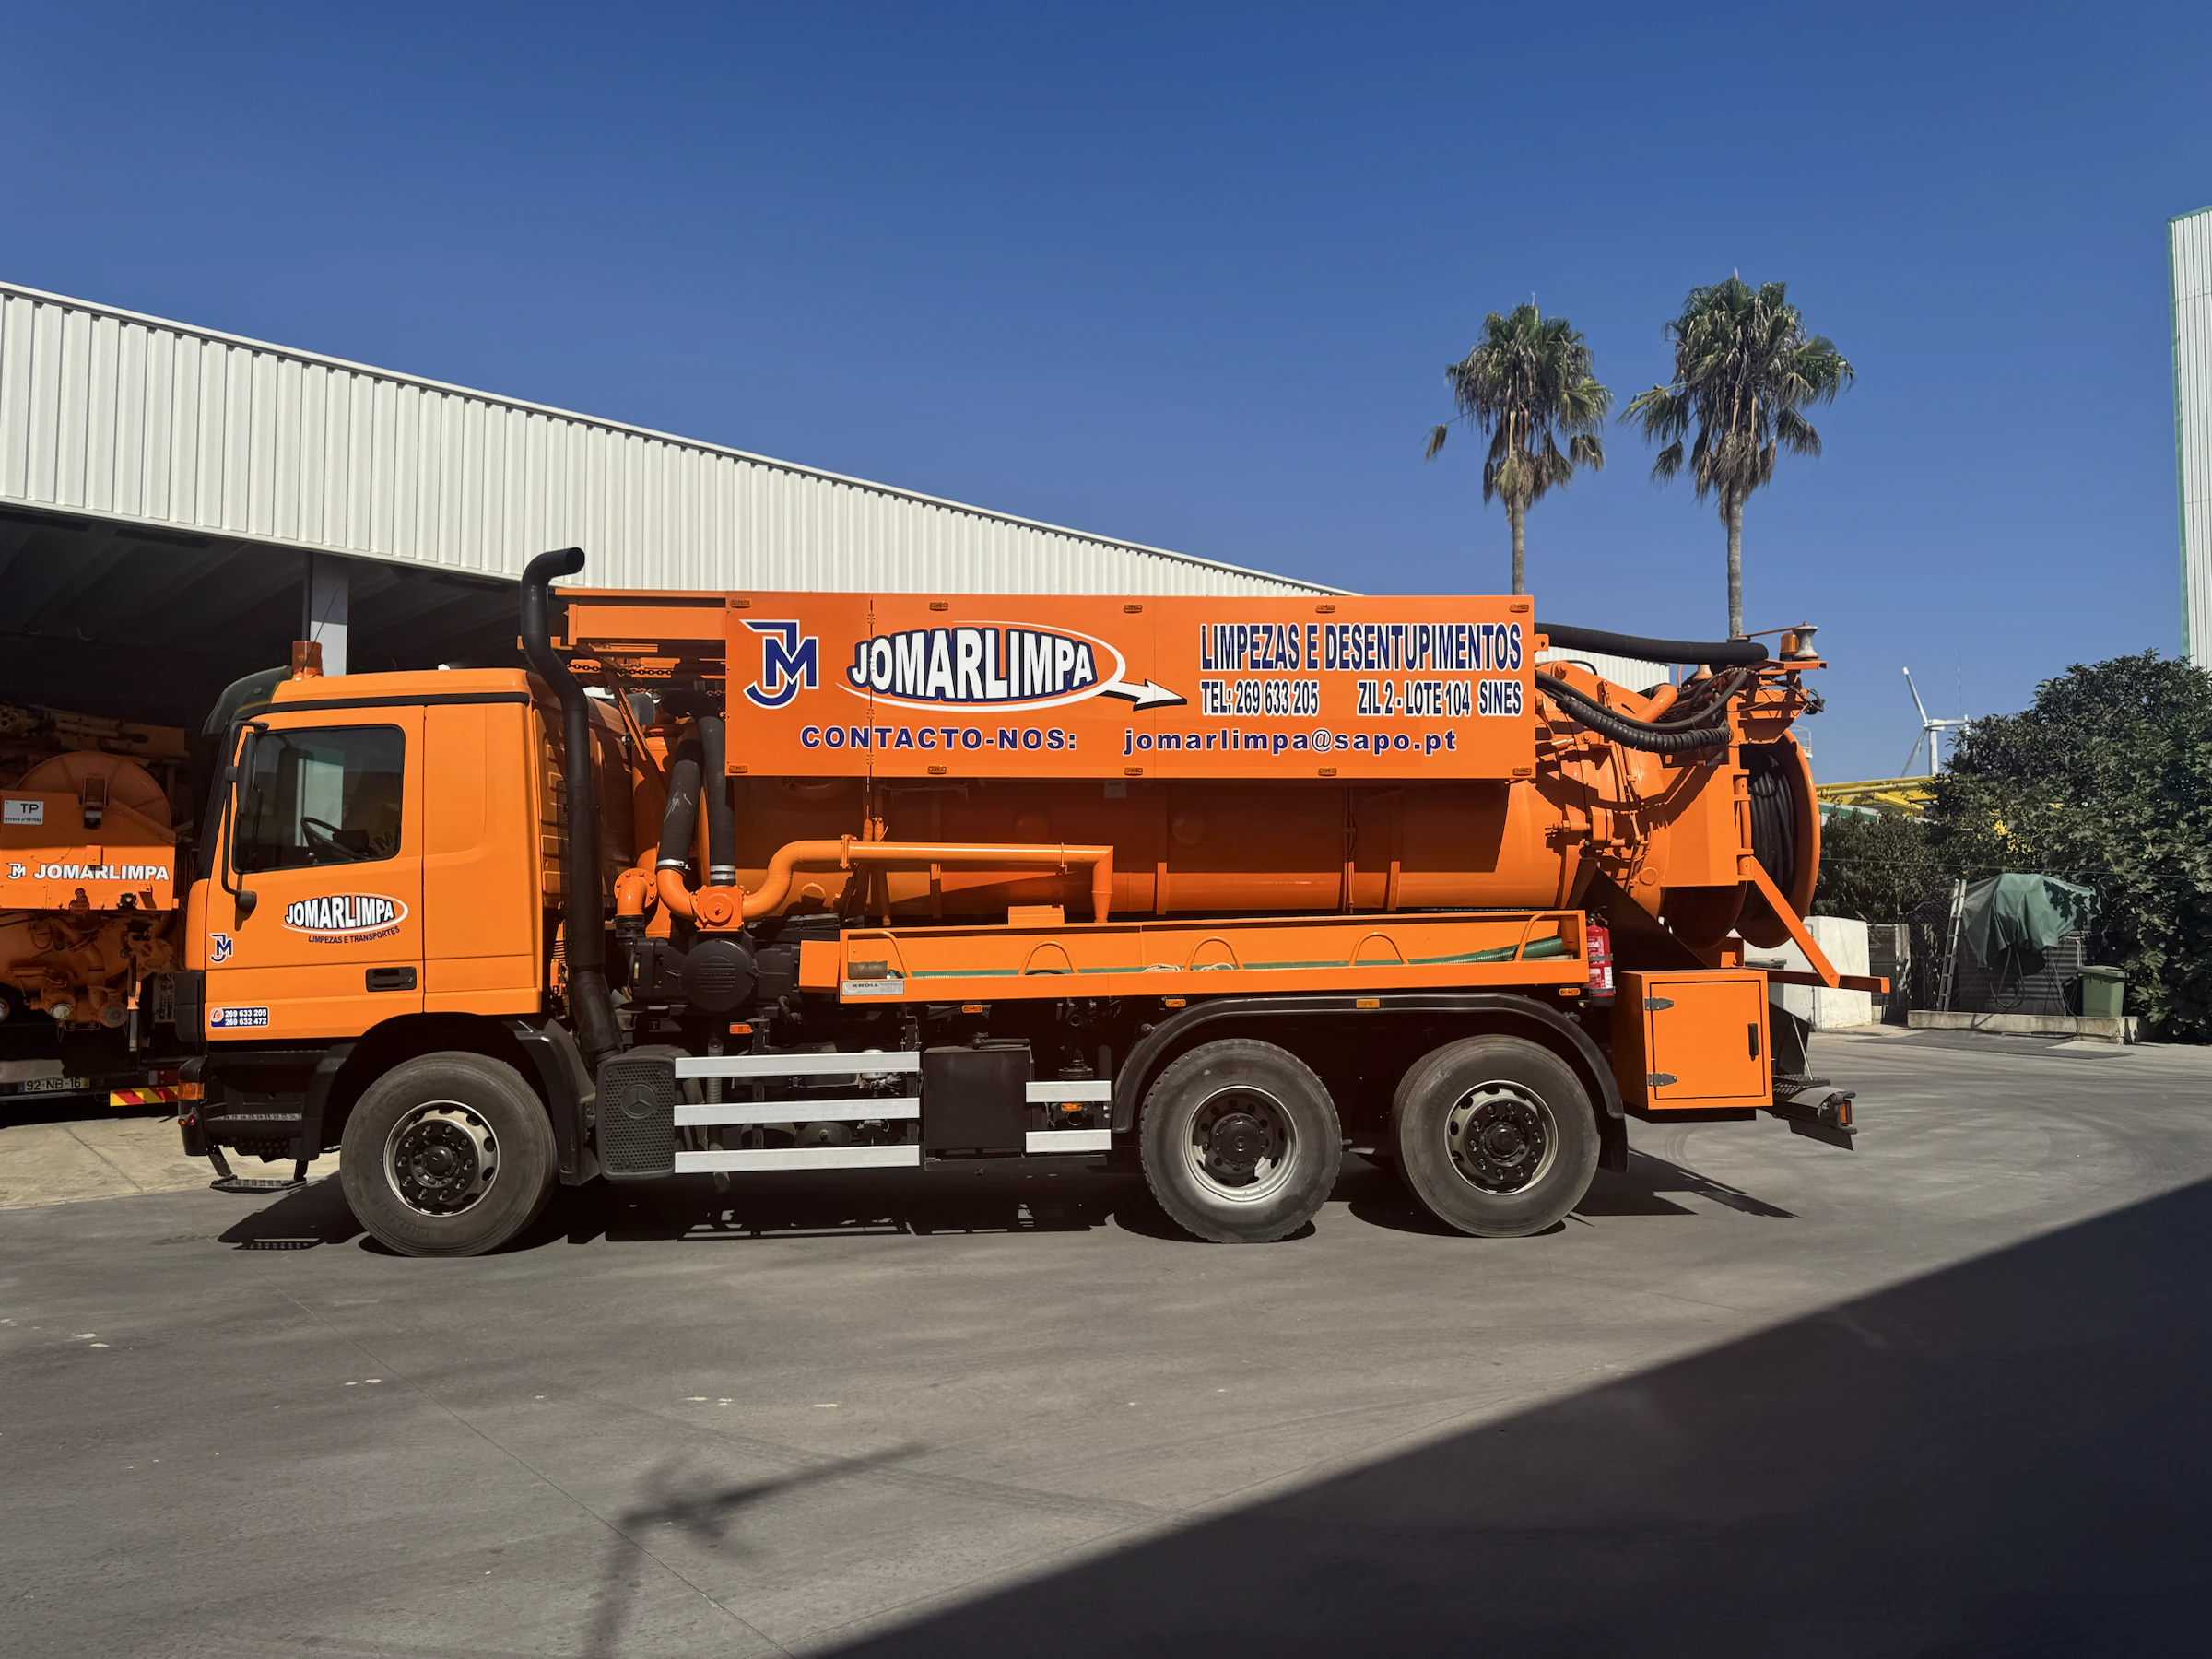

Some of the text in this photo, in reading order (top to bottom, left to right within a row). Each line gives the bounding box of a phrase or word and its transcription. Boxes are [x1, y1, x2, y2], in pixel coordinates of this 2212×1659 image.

[1200, 622, 1523, 672] LIMPEZAS E DESENTUPIMENTOS
[847, 627, 1098, 703] JOMARLIMPA
[1200, 679, 1233, 716] TEL:
[1234, 679, 1262, 716] 269
[1263, 679, 1291, 716] 633
[1291, 679, 1320, 716] 205
[1357, 680, 1382, 716] ZIL
[1382, 680, 1394, 716] 2
[1404, 680, 1442, 716] LOTE
[1443, 680, 1472, 716] 104
[1477, 679, 1523, 716] SINES
[800, 725, 1457, 756] CONTACTO-NOS: jomarlimpa@sapo.pt
[20, 803, 39, 814] TP
[33, 864, 170, 881] JOMARLIMPA
[284, 895, 396, 929] JOMARLIMPA
[308, 925, 400, 945] LIMPEZAS E TRANSPORTES
[239, 1009, 253, 1018] 633
[26, 1077, 81, 1091] 92-NB-16
